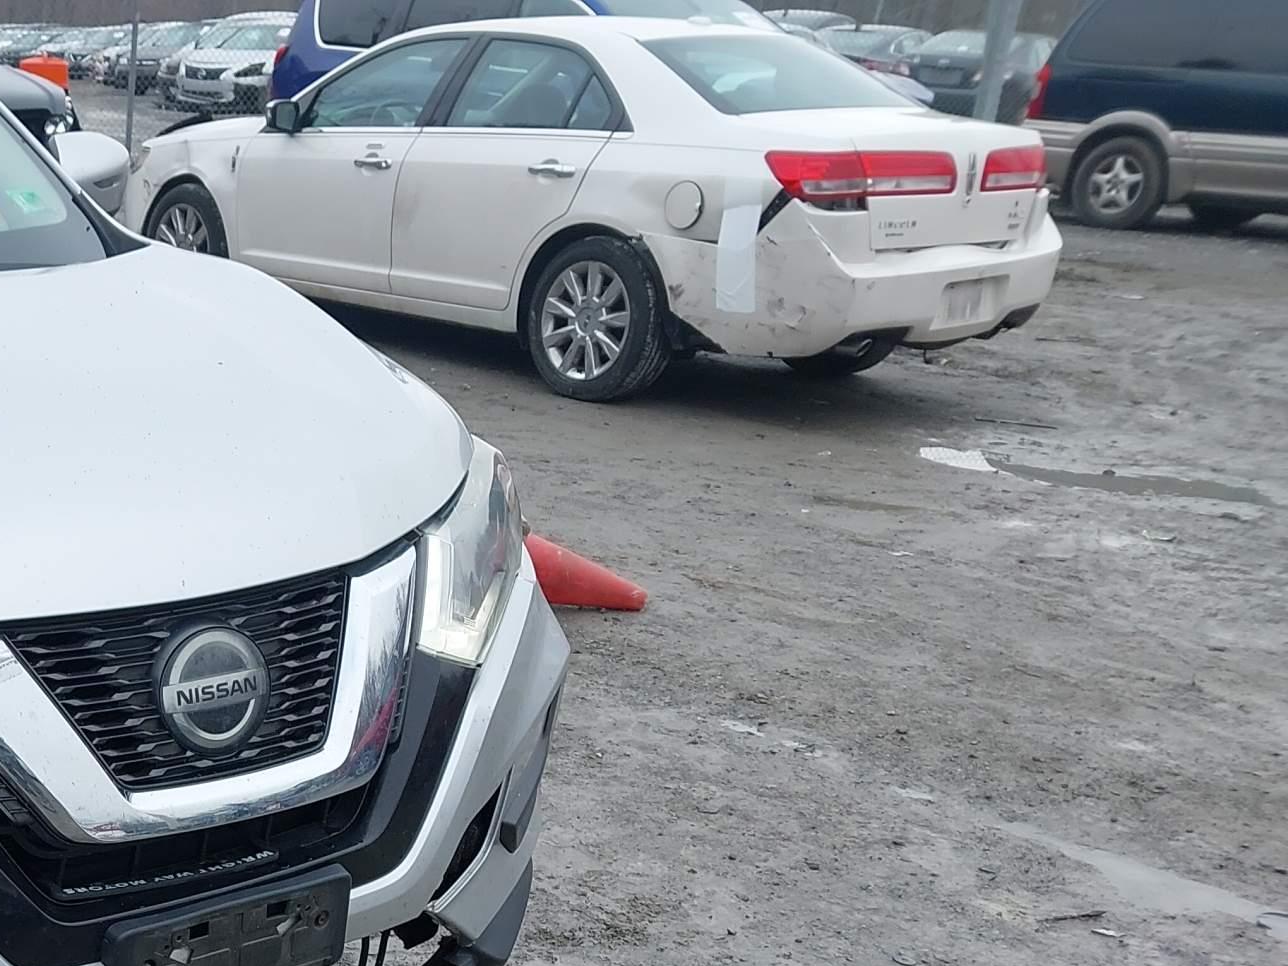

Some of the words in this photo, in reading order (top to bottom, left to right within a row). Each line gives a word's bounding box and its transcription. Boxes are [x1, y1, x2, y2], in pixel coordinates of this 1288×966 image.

[176, 675, 257, 706] NISSAN
[198, 850, 274, 875] WRIGHT
[63, 879, 147, 895] MOTORS
[154, 871, 195, 883] WAY
